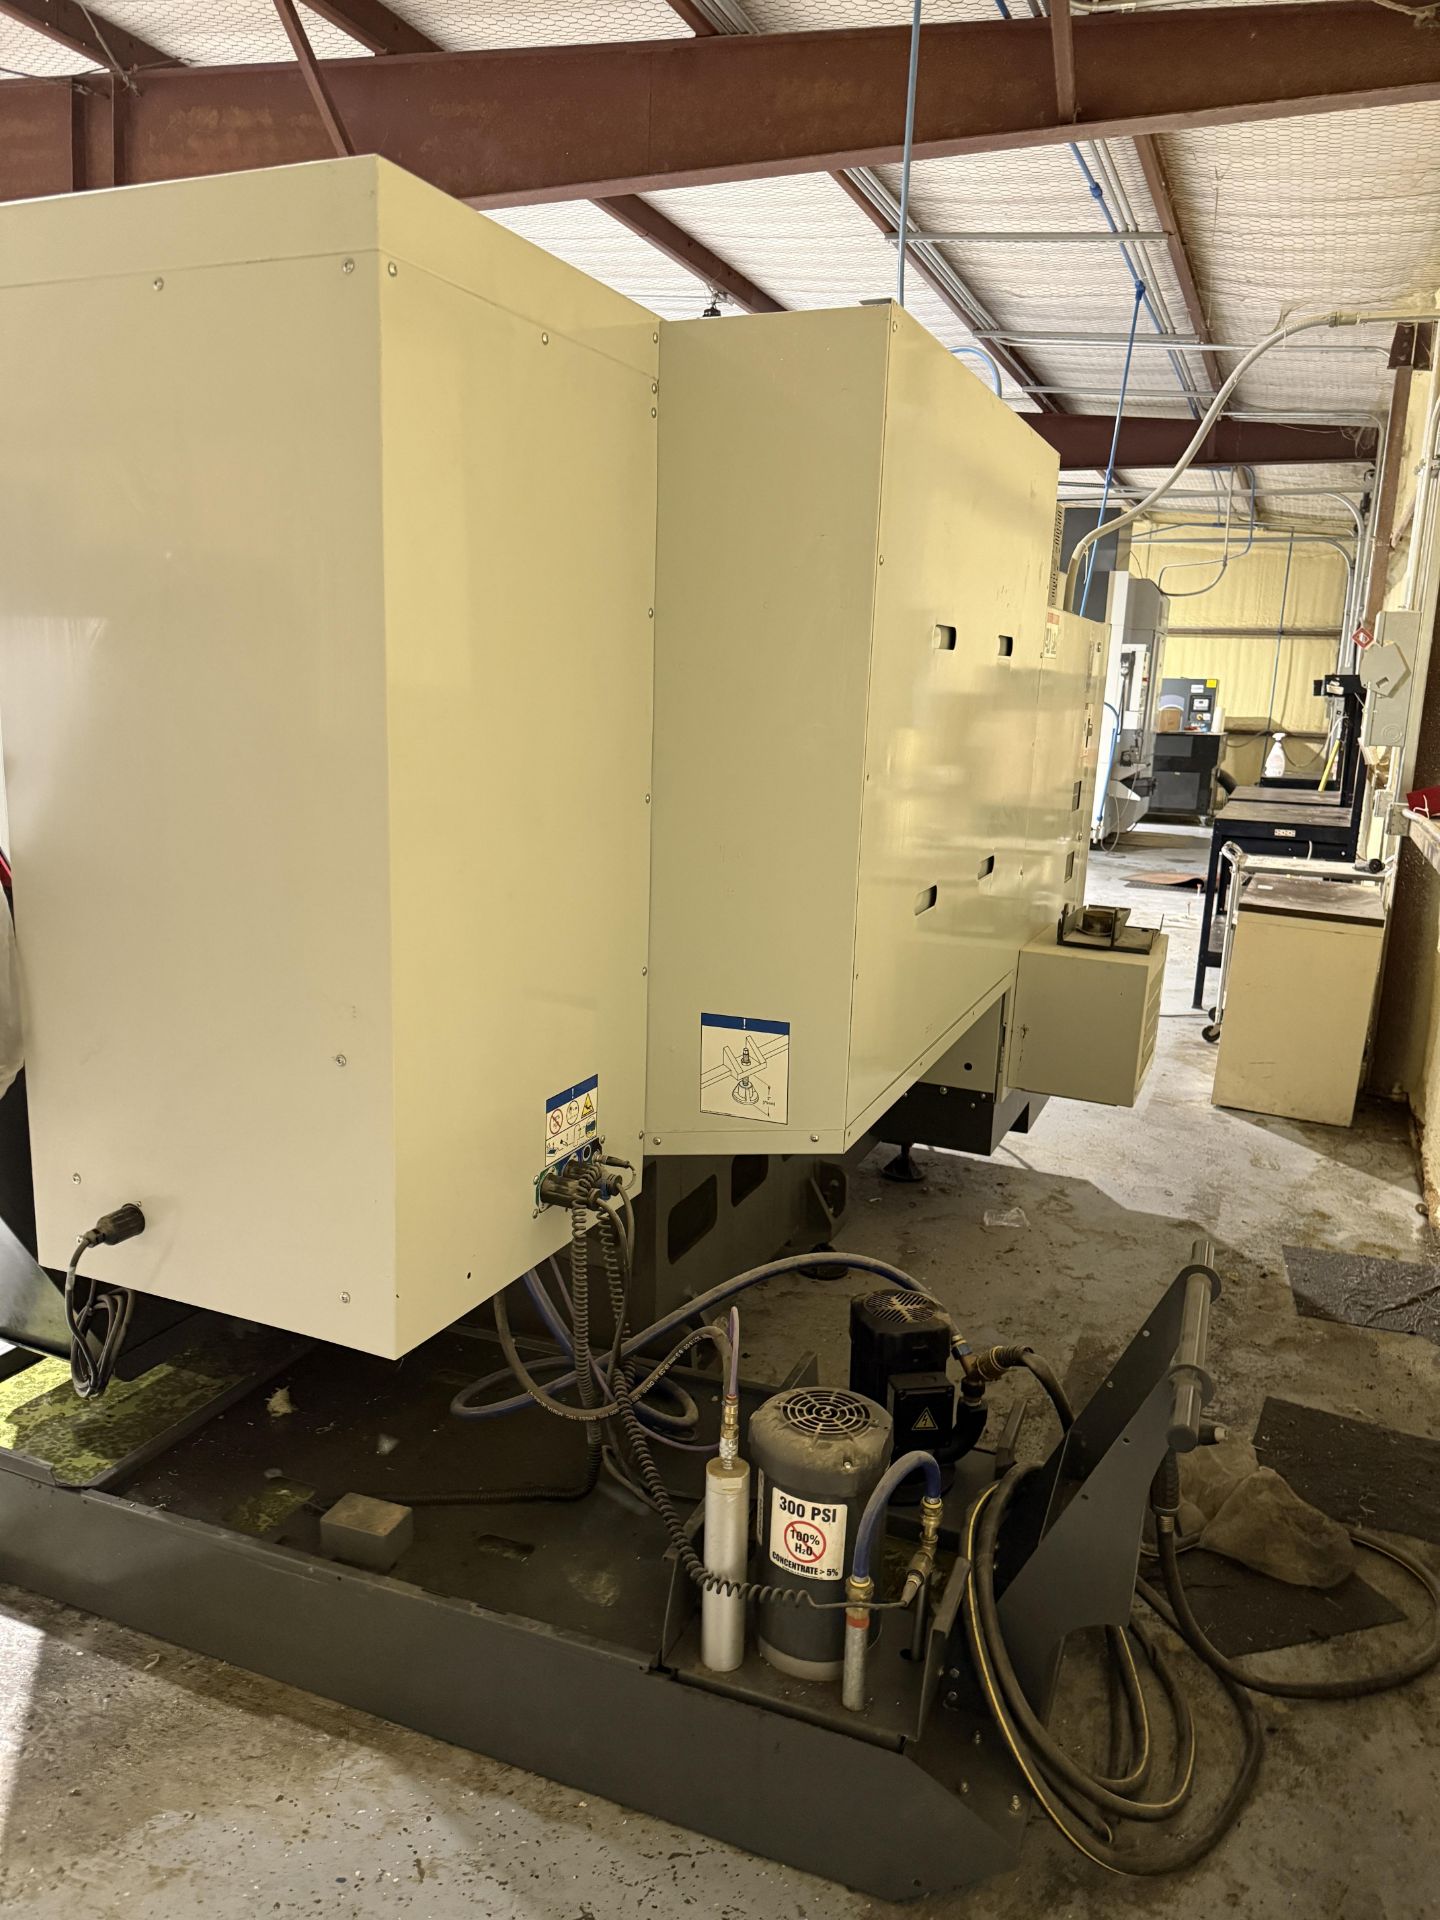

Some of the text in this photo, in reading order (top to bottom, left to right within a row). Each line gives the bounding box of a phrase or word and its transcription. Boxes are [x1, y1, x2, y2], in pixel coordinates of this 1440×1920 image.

[779, 1496, 805, 1518] 300
[811, 1507, 837, 1522] PSI
[790, 1529, 820, 1546] 100%
[772, 1551, 819, 1575] CONCENTRATE
[826, 1568, 839, 1577] 5%
